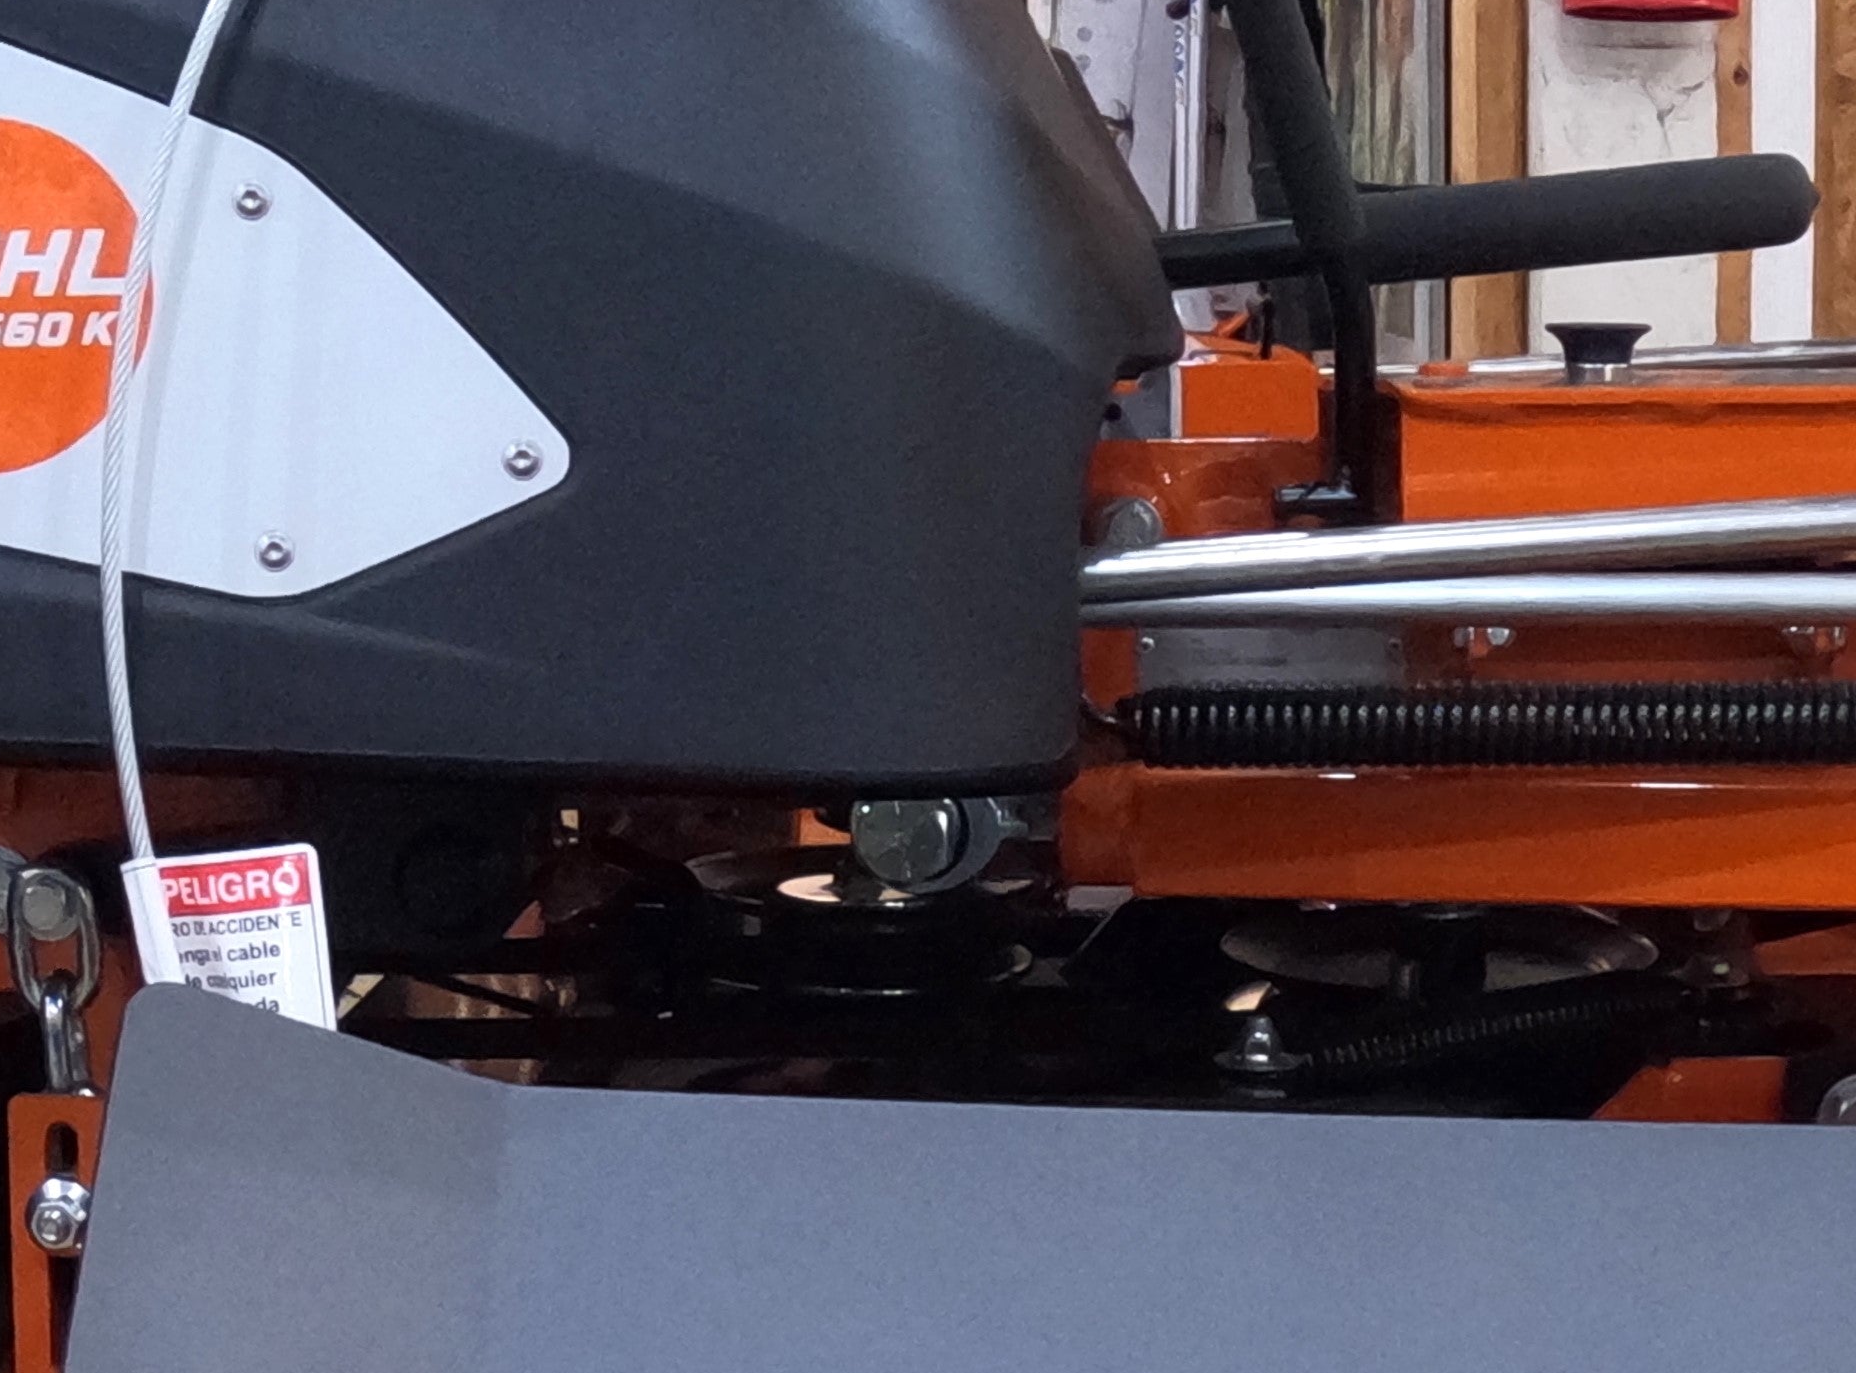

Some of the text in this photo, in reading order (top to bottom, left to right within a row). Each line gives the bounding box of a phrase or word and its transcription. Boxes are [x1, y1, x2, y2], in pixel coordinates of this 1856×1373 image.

[81, 310, 120, 347] K
[162, 864, 302, 906] PELIGRO
[227, 940, 281, 962] cable
